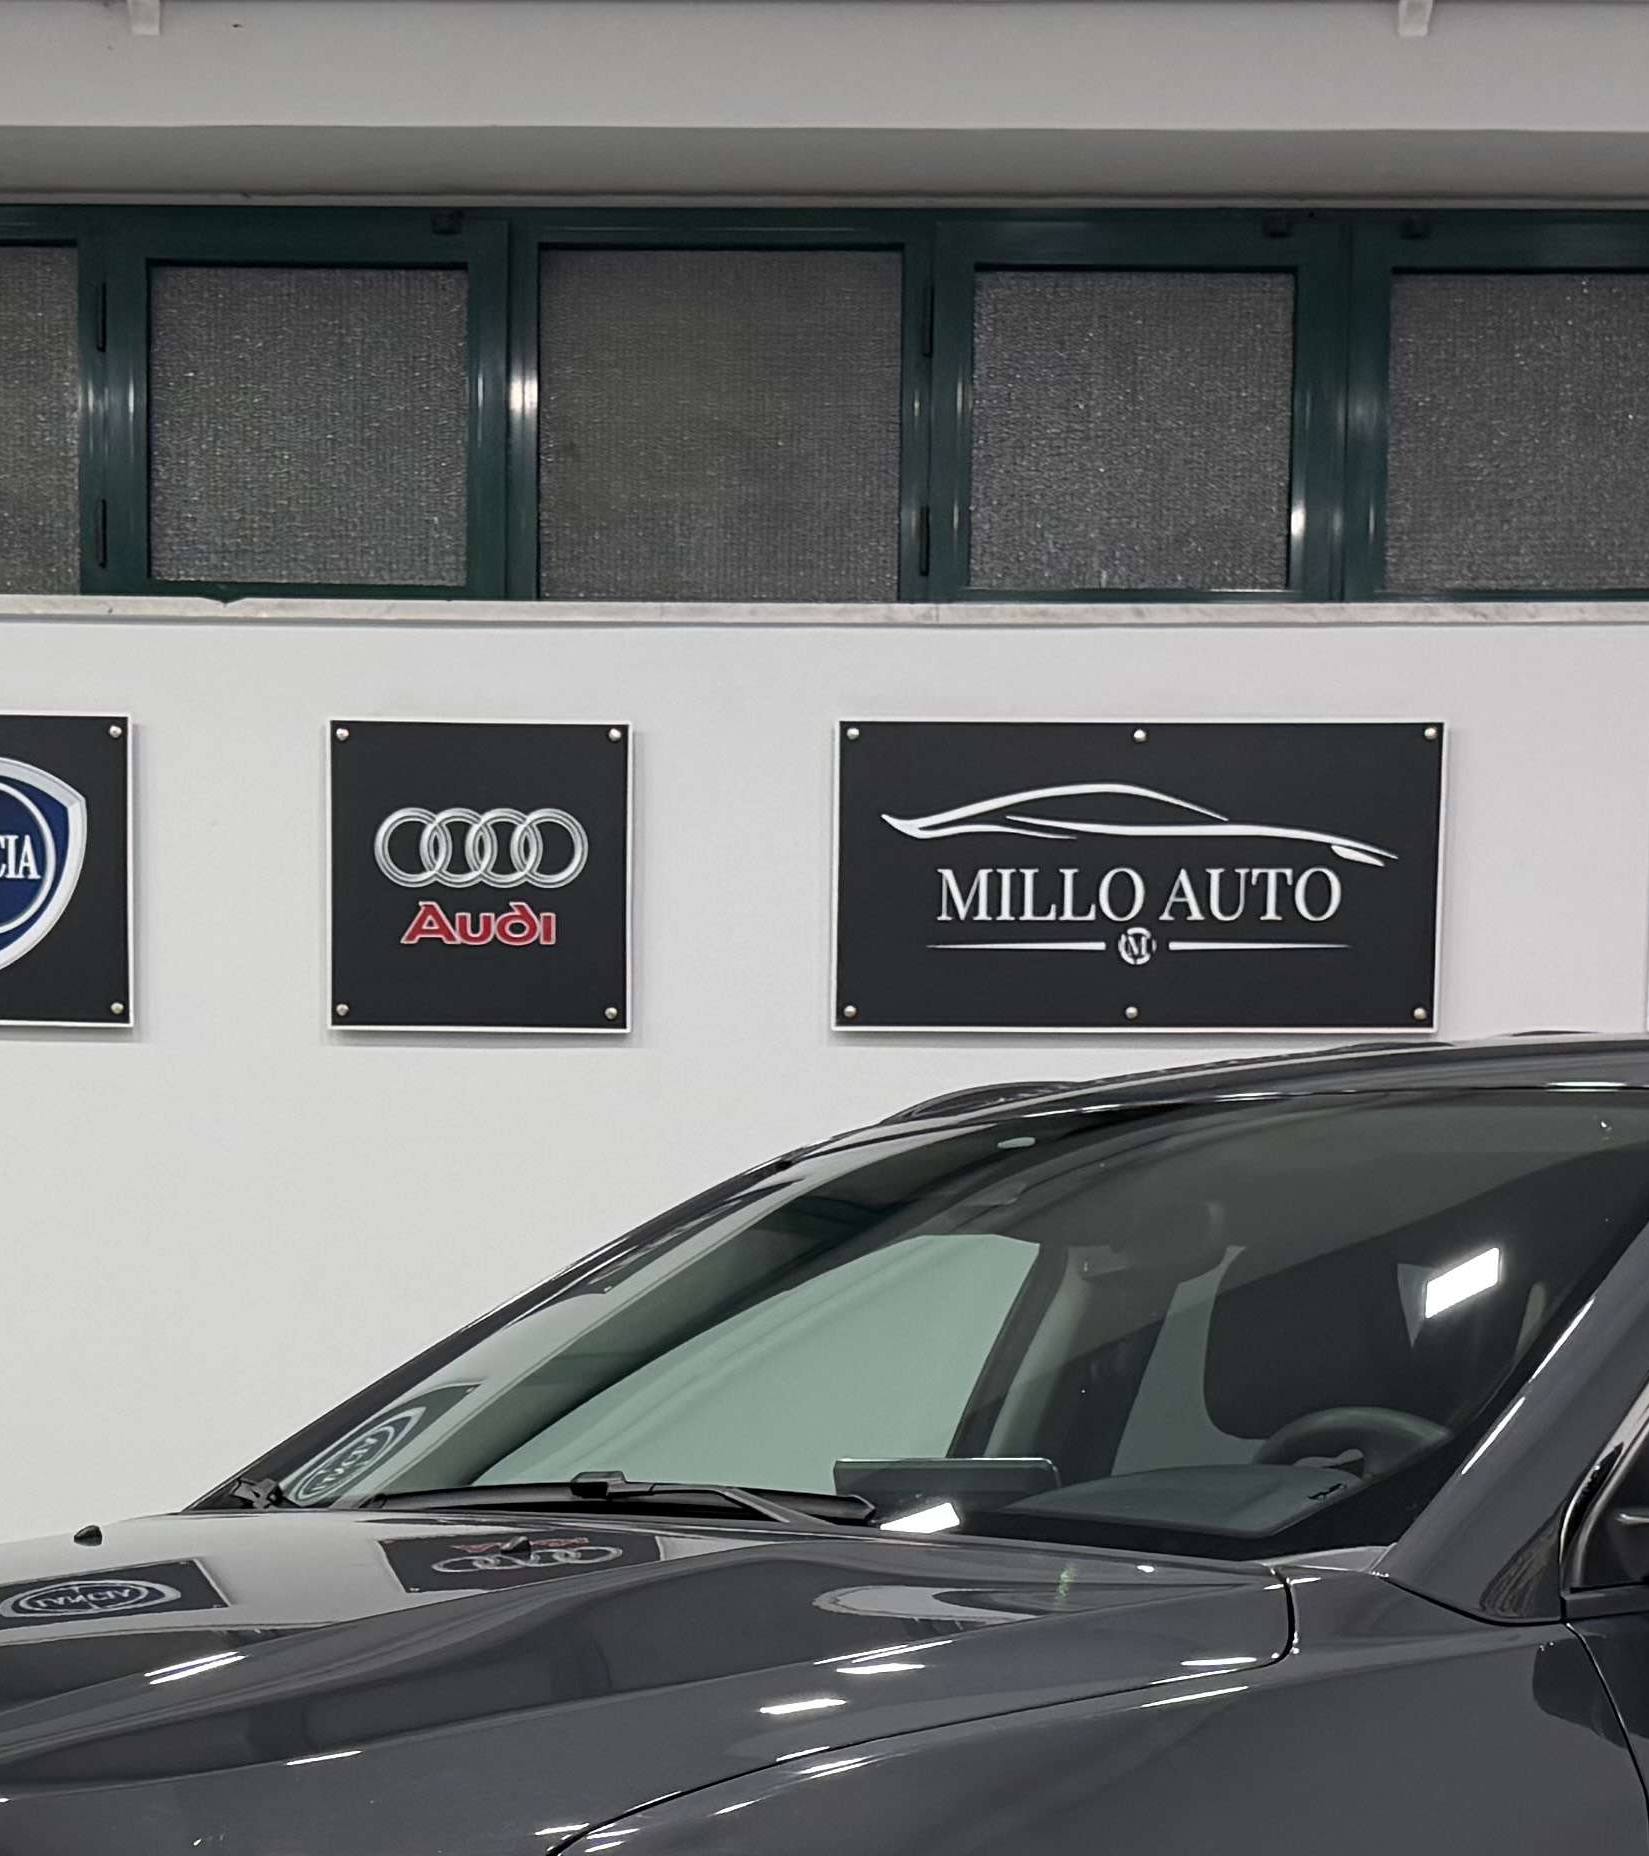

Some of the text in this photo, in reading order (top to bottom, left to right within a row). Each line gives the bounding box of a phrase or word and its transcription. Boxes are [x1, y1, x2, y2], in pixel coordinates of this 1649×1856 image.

[935, 866, 1342, 923] MILLO AUTO
[400, 901, 556, 946] Audi
